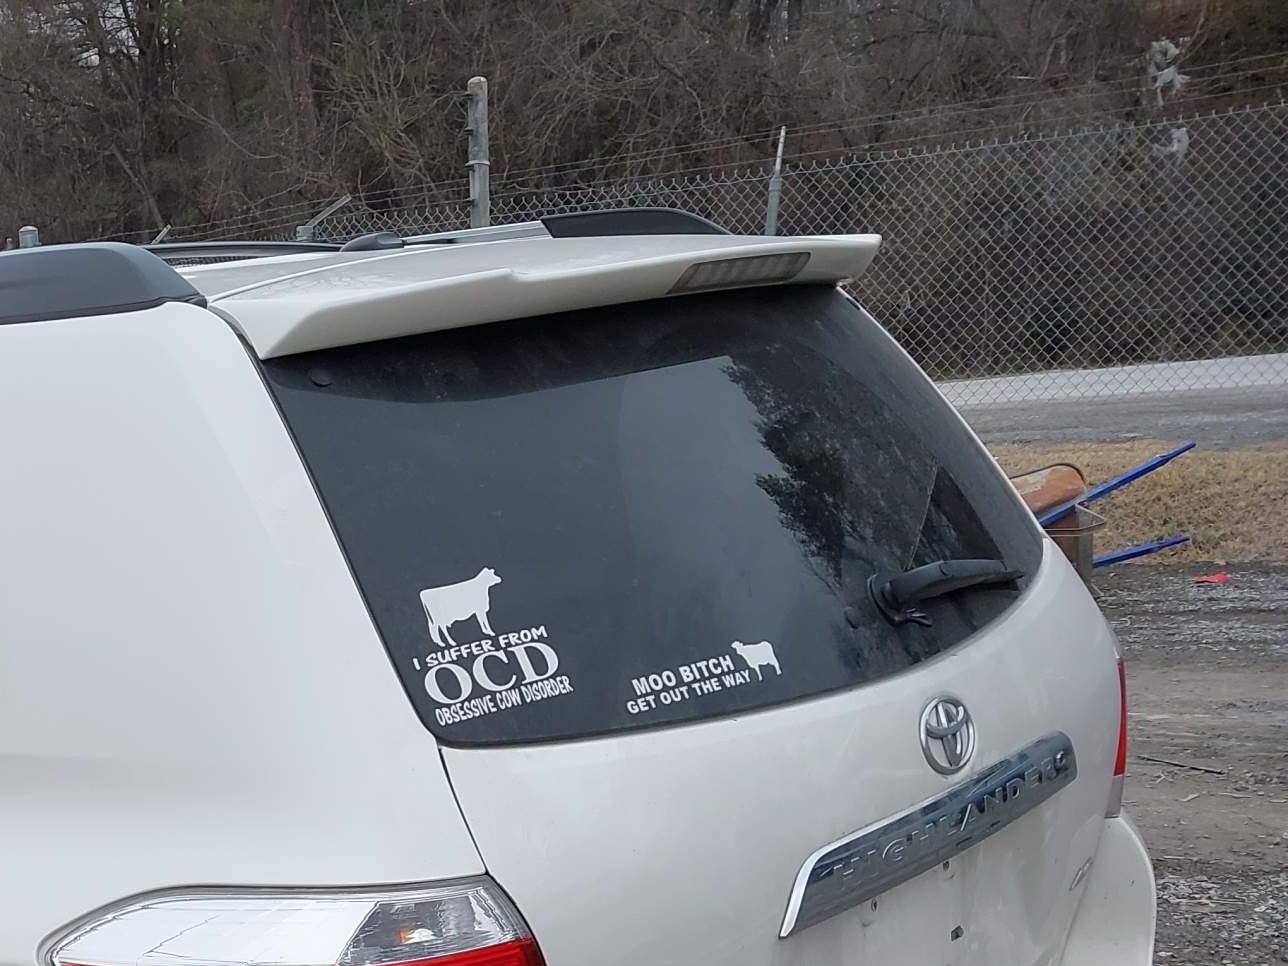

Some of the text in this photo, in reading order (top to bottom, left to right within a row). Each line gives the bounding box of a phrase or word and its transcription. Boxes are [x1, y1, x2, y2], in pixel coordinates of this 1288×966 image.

[413, 626, 548, 670] I SUFFER FROM
[424, 642, 559, 704] OCD
[626, 669, 751, 714] GET OUT THE WAY
[632, 655, 735, 696] MOO BITCH
[435, 675, 573, 726] OBSESSIVE COW DISORDER
